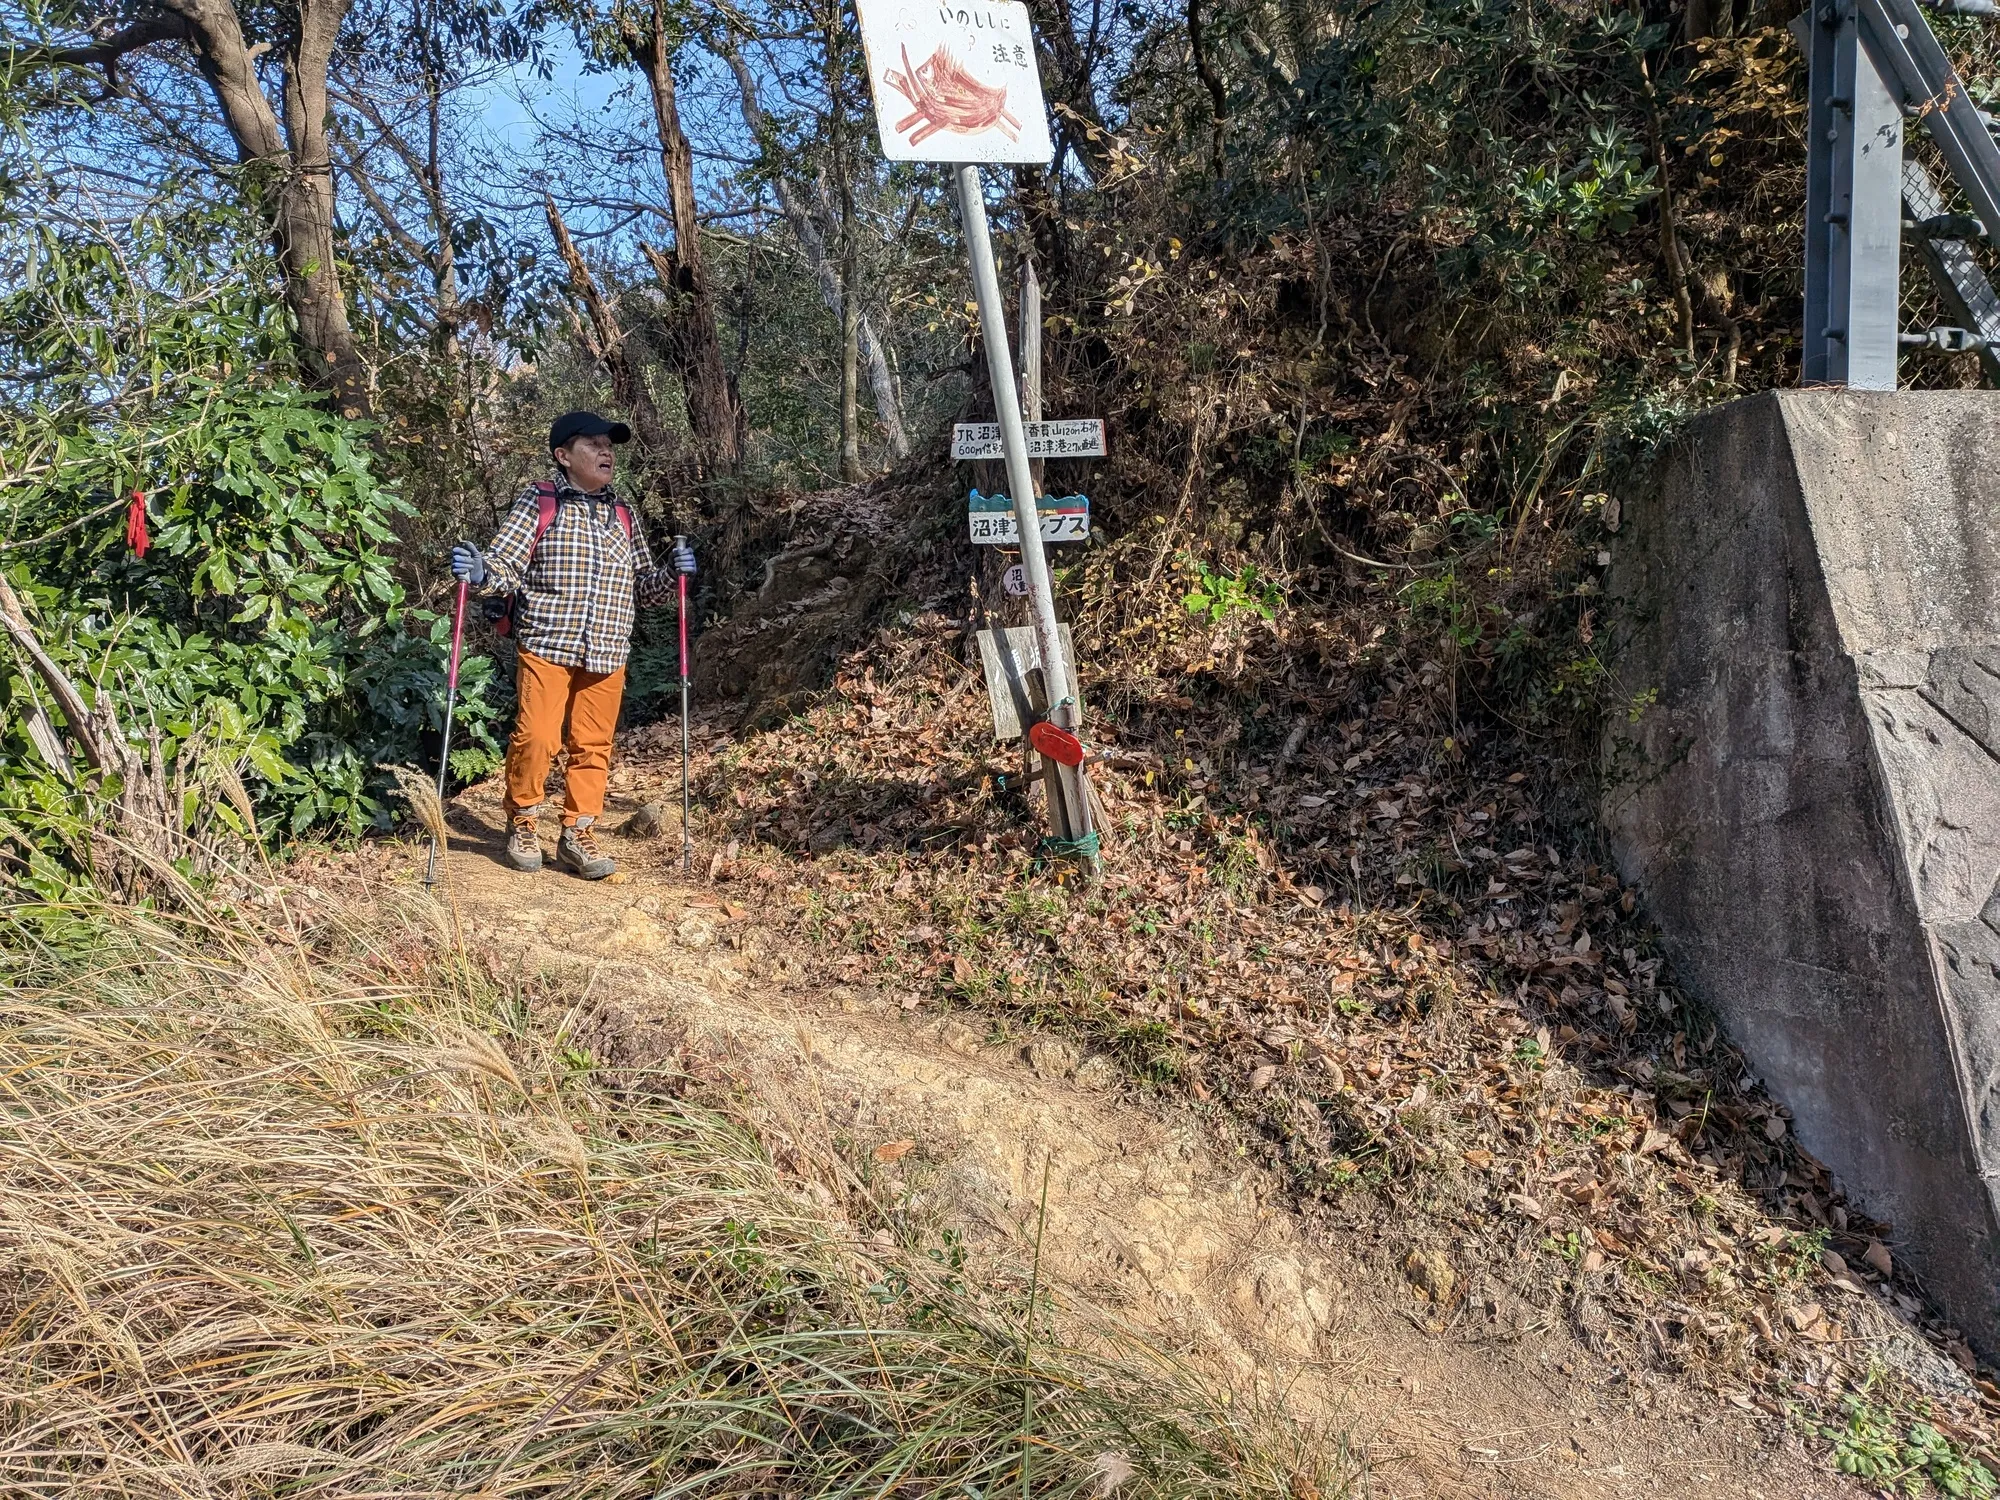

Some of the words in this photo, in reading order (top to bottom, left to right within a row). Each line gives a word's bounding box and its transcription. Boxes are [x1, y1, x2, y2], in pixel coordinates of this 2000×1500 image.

[939, 7, 1010, 30] いのししに
[992, 44, 1028, 69] 注意
[972, 515, 1086, 537] 沼津プス
